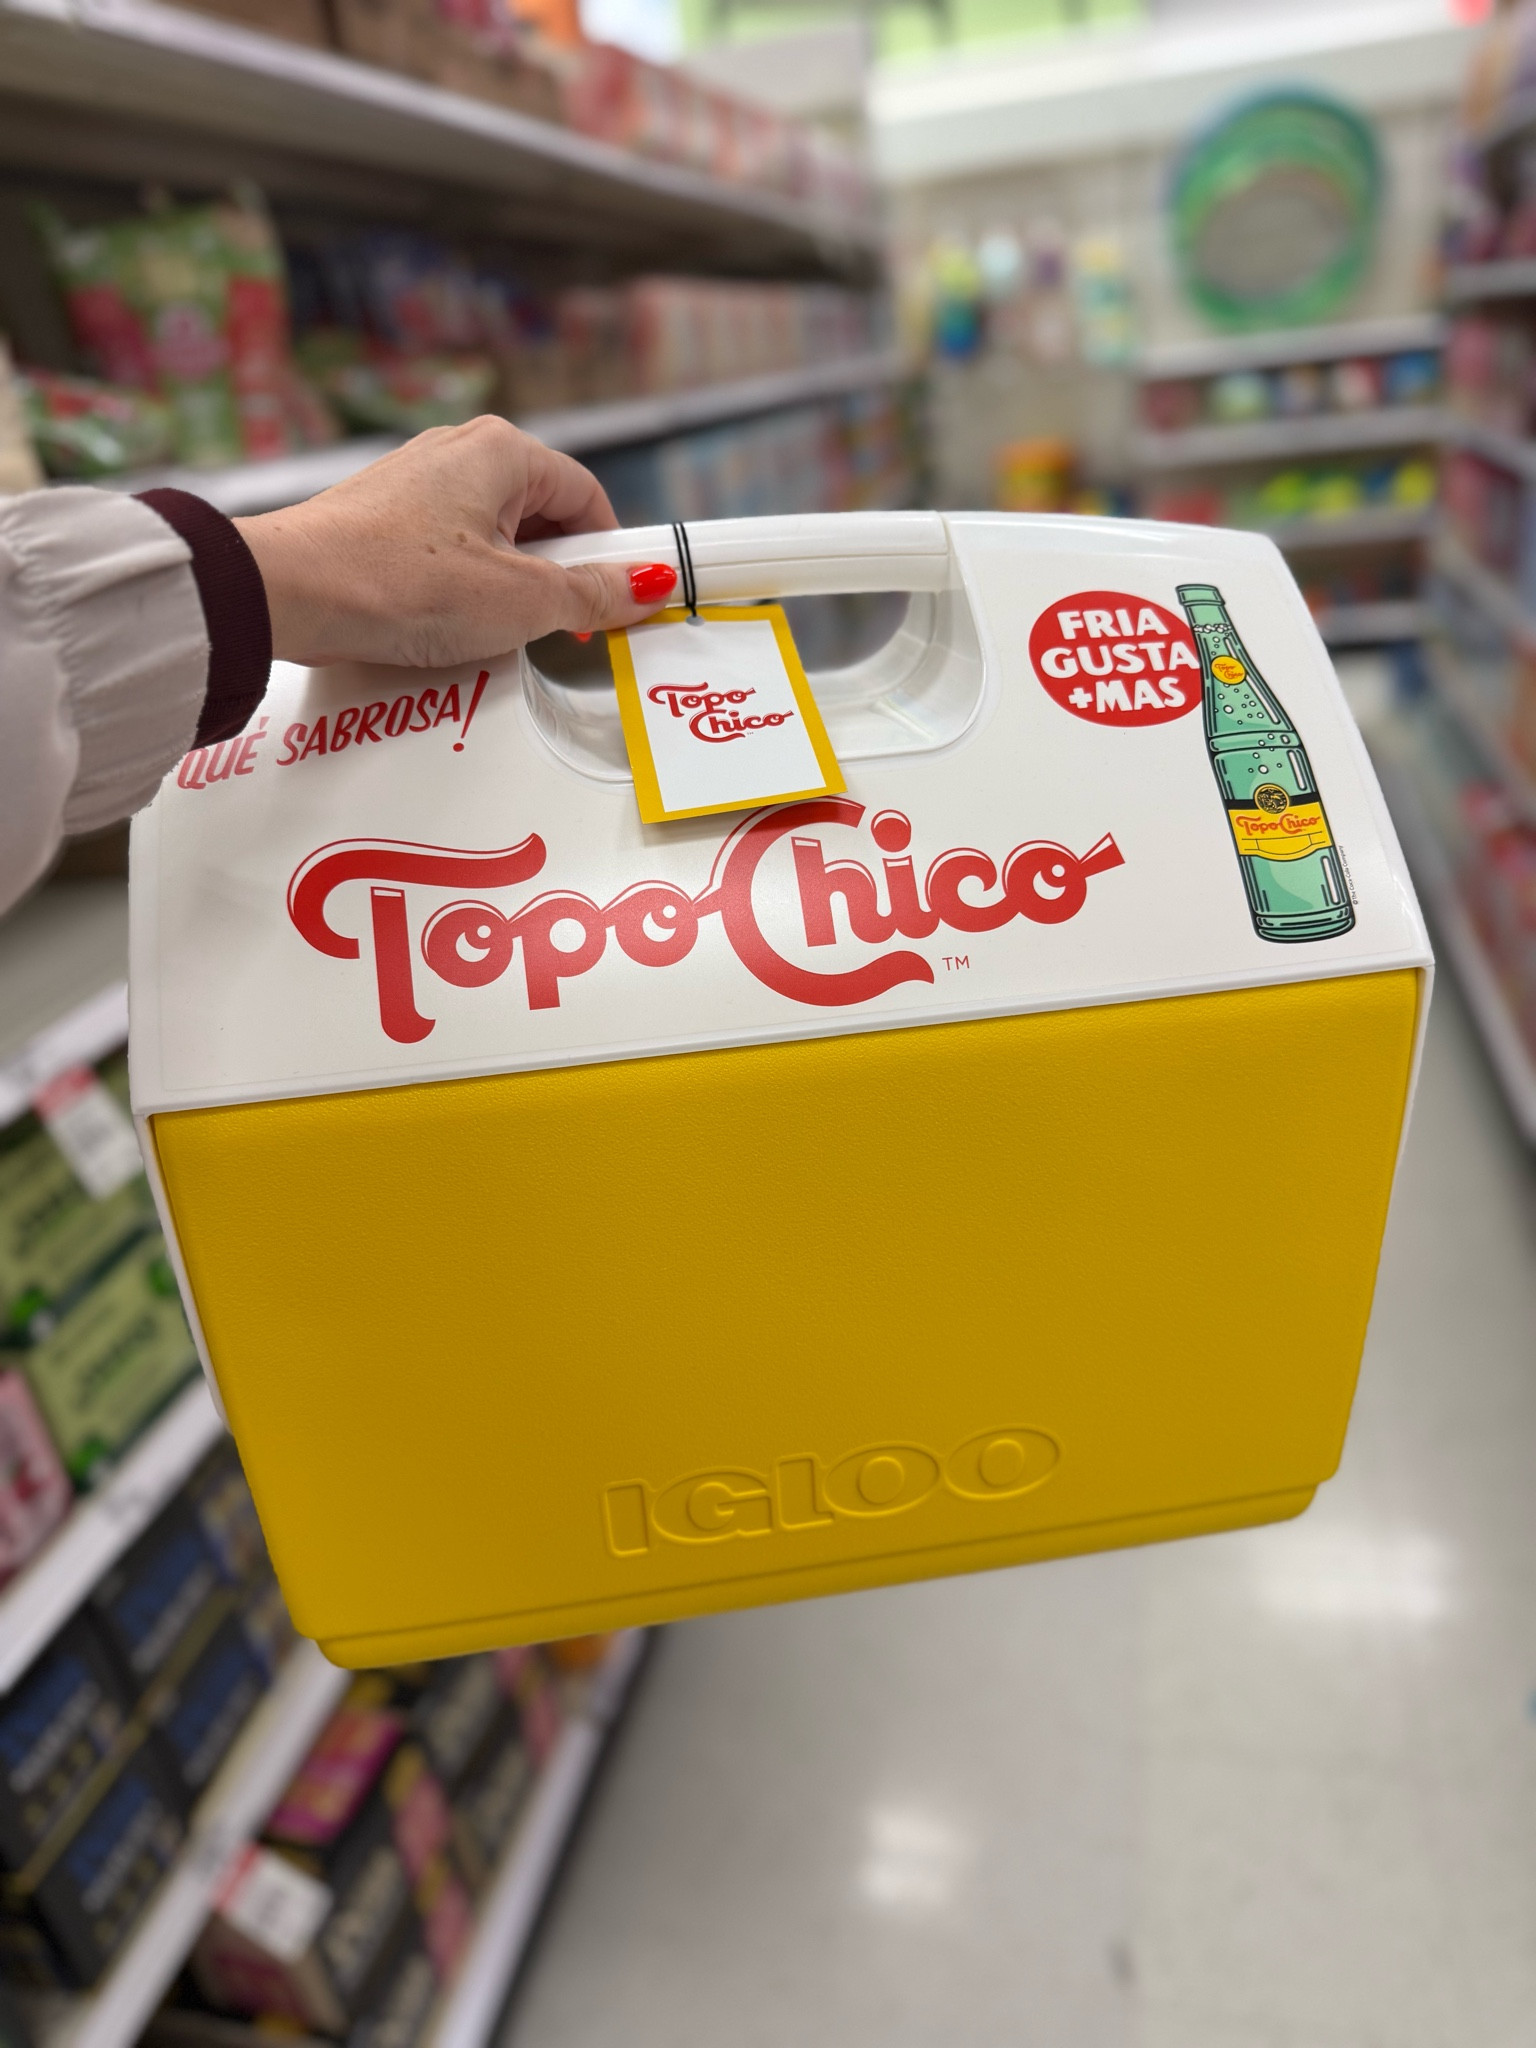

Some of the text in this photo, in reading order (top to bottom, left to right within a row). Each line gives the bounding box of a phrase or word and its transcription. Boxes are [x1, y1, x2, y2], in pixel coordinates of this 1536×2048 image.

[1057, 608, 1170, 640] FRIA
[1040, 641, 1200, 679] GUSTA
[647, 682, 756, 718] Topo
[1068, 677, 1186, 713] +MAS
[176, 670, 490, 790] QUÉ SABROSA!
[689, 709, 794, 743] Chico
[1236, 813, 1320, 836] Topo Chico
[287, 795, 1125, 1044] Topo Chico
[603, 1424, 1063, 1558] IGLOO
